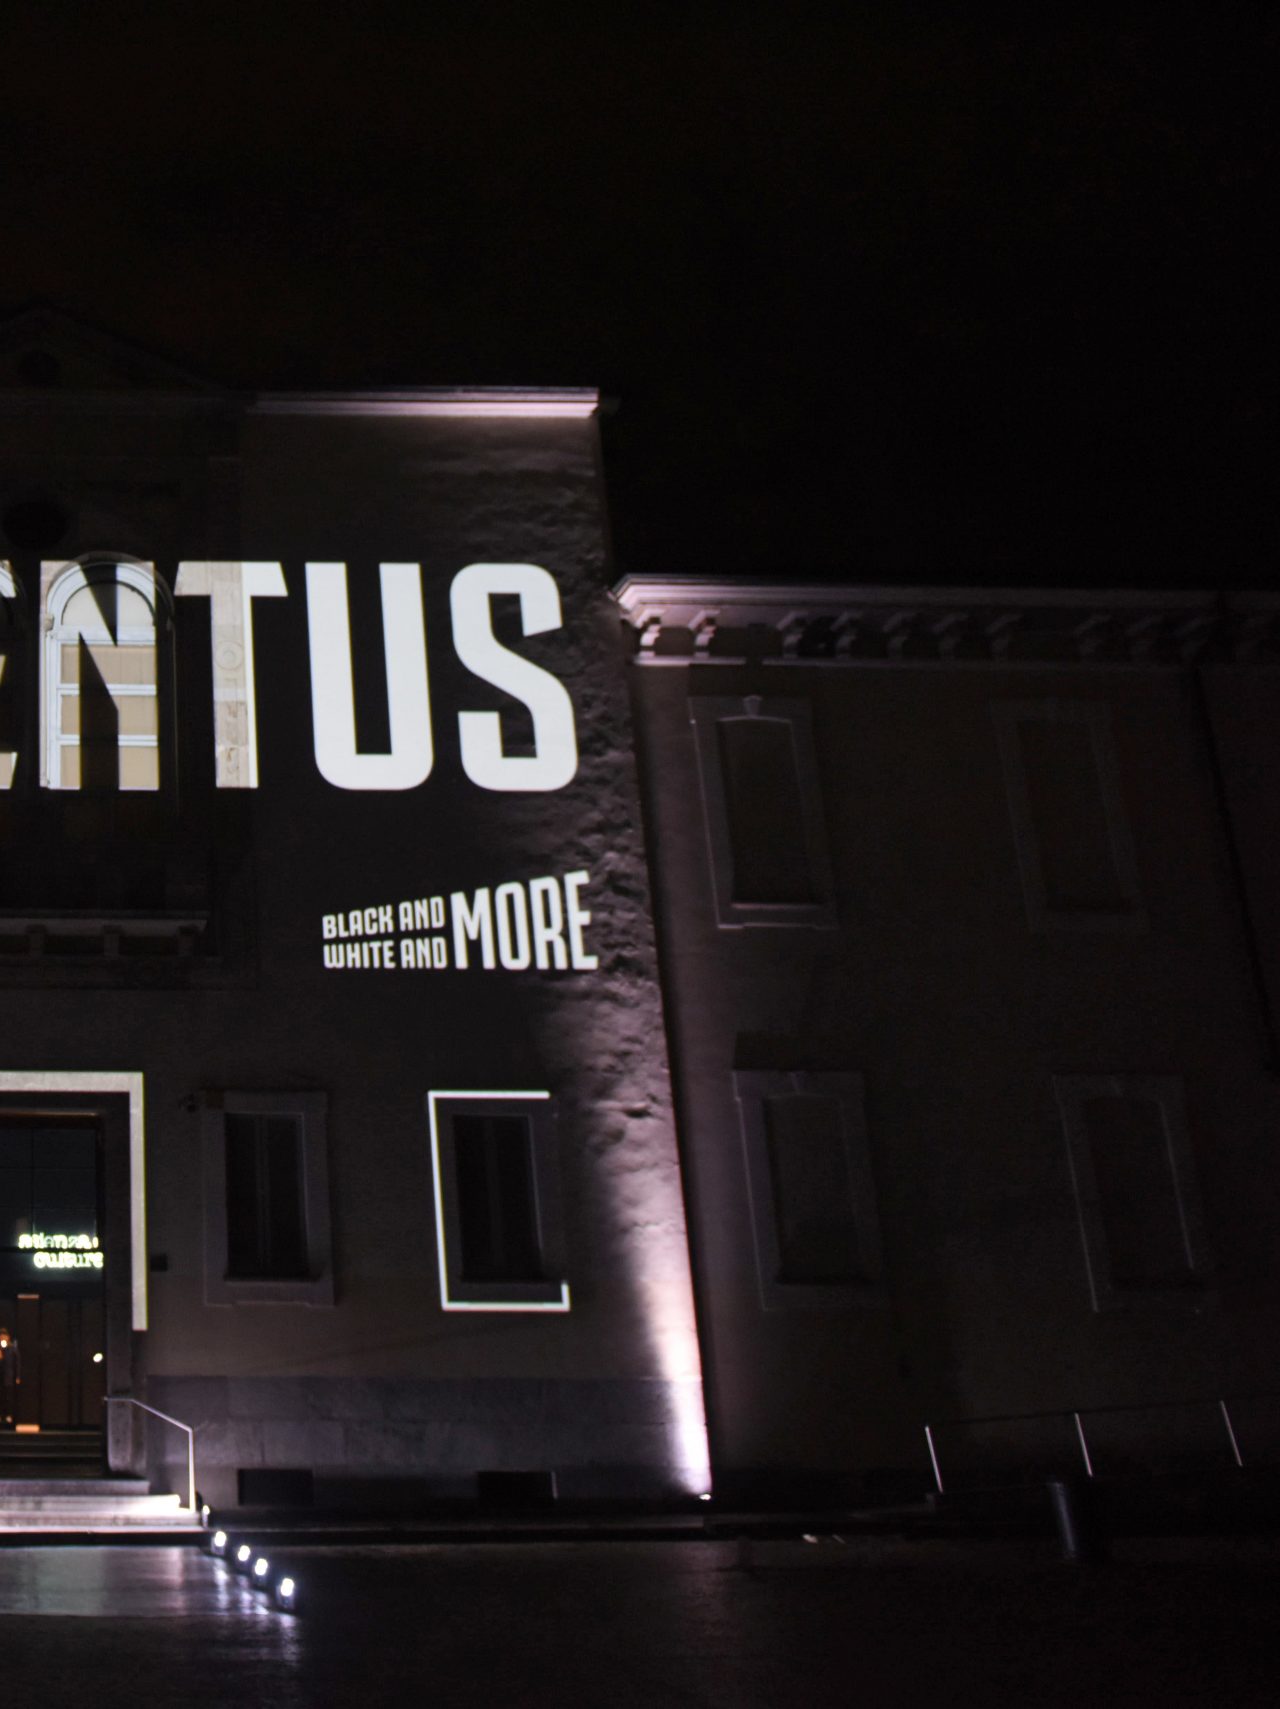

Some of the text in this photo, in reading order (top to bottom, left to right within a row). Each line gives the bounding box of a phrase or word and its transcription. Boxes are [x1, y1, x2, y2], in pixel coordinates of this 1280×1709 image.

[322, 896, 445, 939] BLACK AND
[450, 870, 599, 970] MORE
[323, 937, 448, 969] WHITE AND
